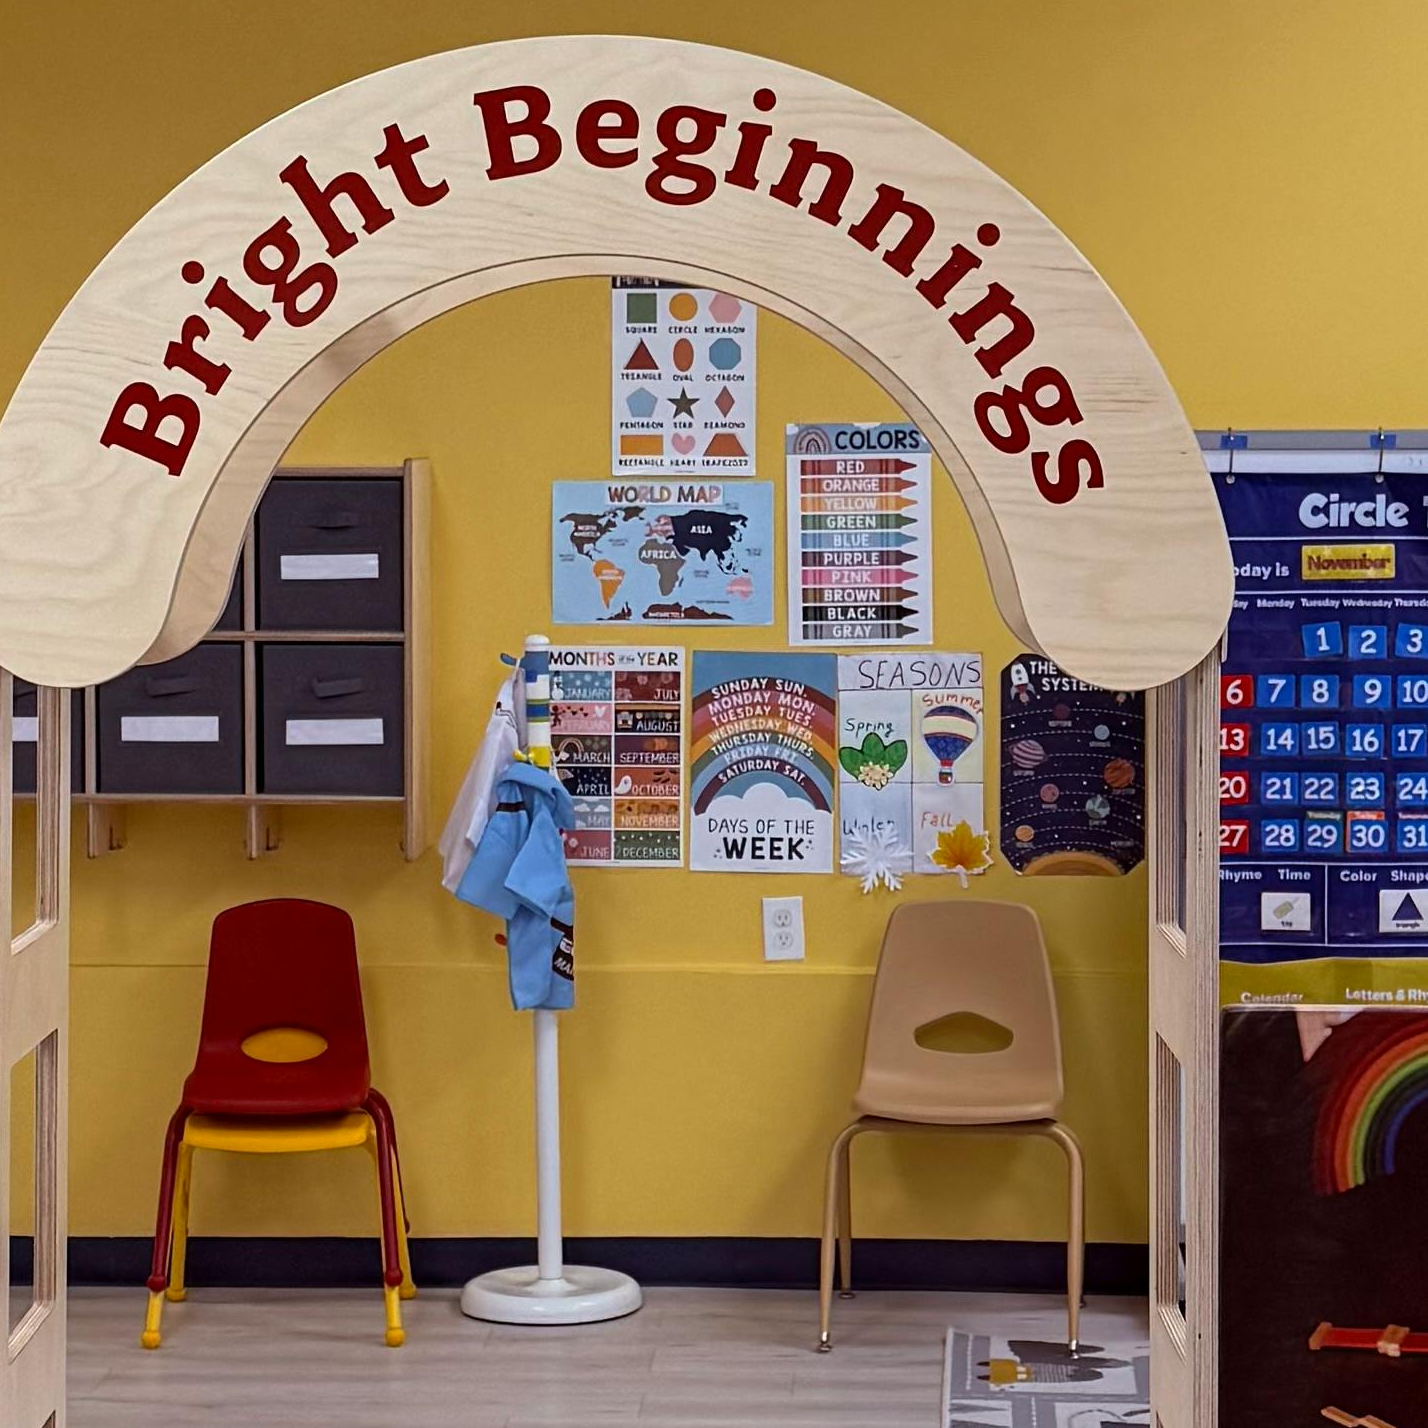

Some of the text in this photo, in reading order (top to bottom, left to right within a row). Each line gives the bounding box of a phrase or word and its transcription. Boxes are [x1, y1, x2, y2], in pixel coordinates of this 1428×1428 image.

[99, 84, 1105, 506] Bright Beginnings
[835, 430, 920, 450] COLORS
[836, 461, 865, 473] RED
[823, 479, 879, 492] ORANGE
[608, 486, 721, 503] WORLD MAP
[824, 498, 877, 510] YELLOW
[1298, 493, 1409, 528] Circle
[690, 525, 712, 534] ASIA
[827, 516, 876, 528] GREEN
[834, 534, 869, 546] BLUE
[641, 550, 677, 559] AFRICA
[824, 552, 879, 565] PURPLE
[1233, 562, 1272, 580] oday
[1276, 562, 1290, 577] is
[1307, 554, 1391, 571] November
[832, 571, 871, 583] PINK
[825, 589, 880, 601] BROWN
[828, 607, 876, 619] BLACK
[833, 626, 872, 638] GRAY
[1316, 627, 1330, 651] 1
[1361, 630, 1377, 653] 2
[1406, 629, 1422, 652] 3
[549, 652, 678, 666] MONTHS YEAR
[859, 660, 981, 689] SEASONS
[1030, 661, 1057, 674] THE
[712, 678, 807, 699] SUNDAY SUN.
[1042, 678, 1105, 692] SYSTE
[1226, 683, 1243, 705] 6
[1268, 679, 1286, 702] 7
[1312, 679, 1329, 702] 8
[1364, 679, 1381, 702] 9
[1403, 680, 1428, 702] 10
[564, 688, 679, 700] JANUARY JULY
[708, 692, 816, 716] MONDAY MON.
[923, 694, 983, 715] Summer
[711, 707, 812, 728] TUESDAY TUES.
[636, 721, 678, 732] AUGUST
[709, 719, 781, 743] WEDNESDAY
[845, 718, 894, 739] Spring
[711, 732, 814, 760] THURSDAY THURS.
[1219, 729, 1244, 751] 13
[1266, 728, 1294, 751] 14
[1307, 726, 1334, 749] 15
[1352, 729, 1379, 752] 16
[1398, 729, 1423, 751] 17
[573, 752, 679, 763] MARCH SEPTEMBER
[724, 746, 770, 764] FRIDAY
[718, 760, 805, 786] SATURDAY SAT.
[576, 784, 679, 795] APRIL OCTOBER
[1219, 777, 1246, 798] 20
[1266, 777, 1293, 800] 21
[1304, 777, 1335, 799] 22
[1350, 777, 1380, 800] 23
[1399, 777, 1428, 800] 24
[588, 816, 678, 827] MAY NOVEMBER
[709, 818, 814, 835] DAYS OF THE
[921, 812, 952, 828] Fall
[1219, 825, 1428, 847] 27 28 29 30 31
[580, 846, 678, 858] JUNE DECEMBER
[723, 836, 804, 860] WEEK
[1278, 869, 1311, 881] Time
[1340, 870, 1377, 882] Color
